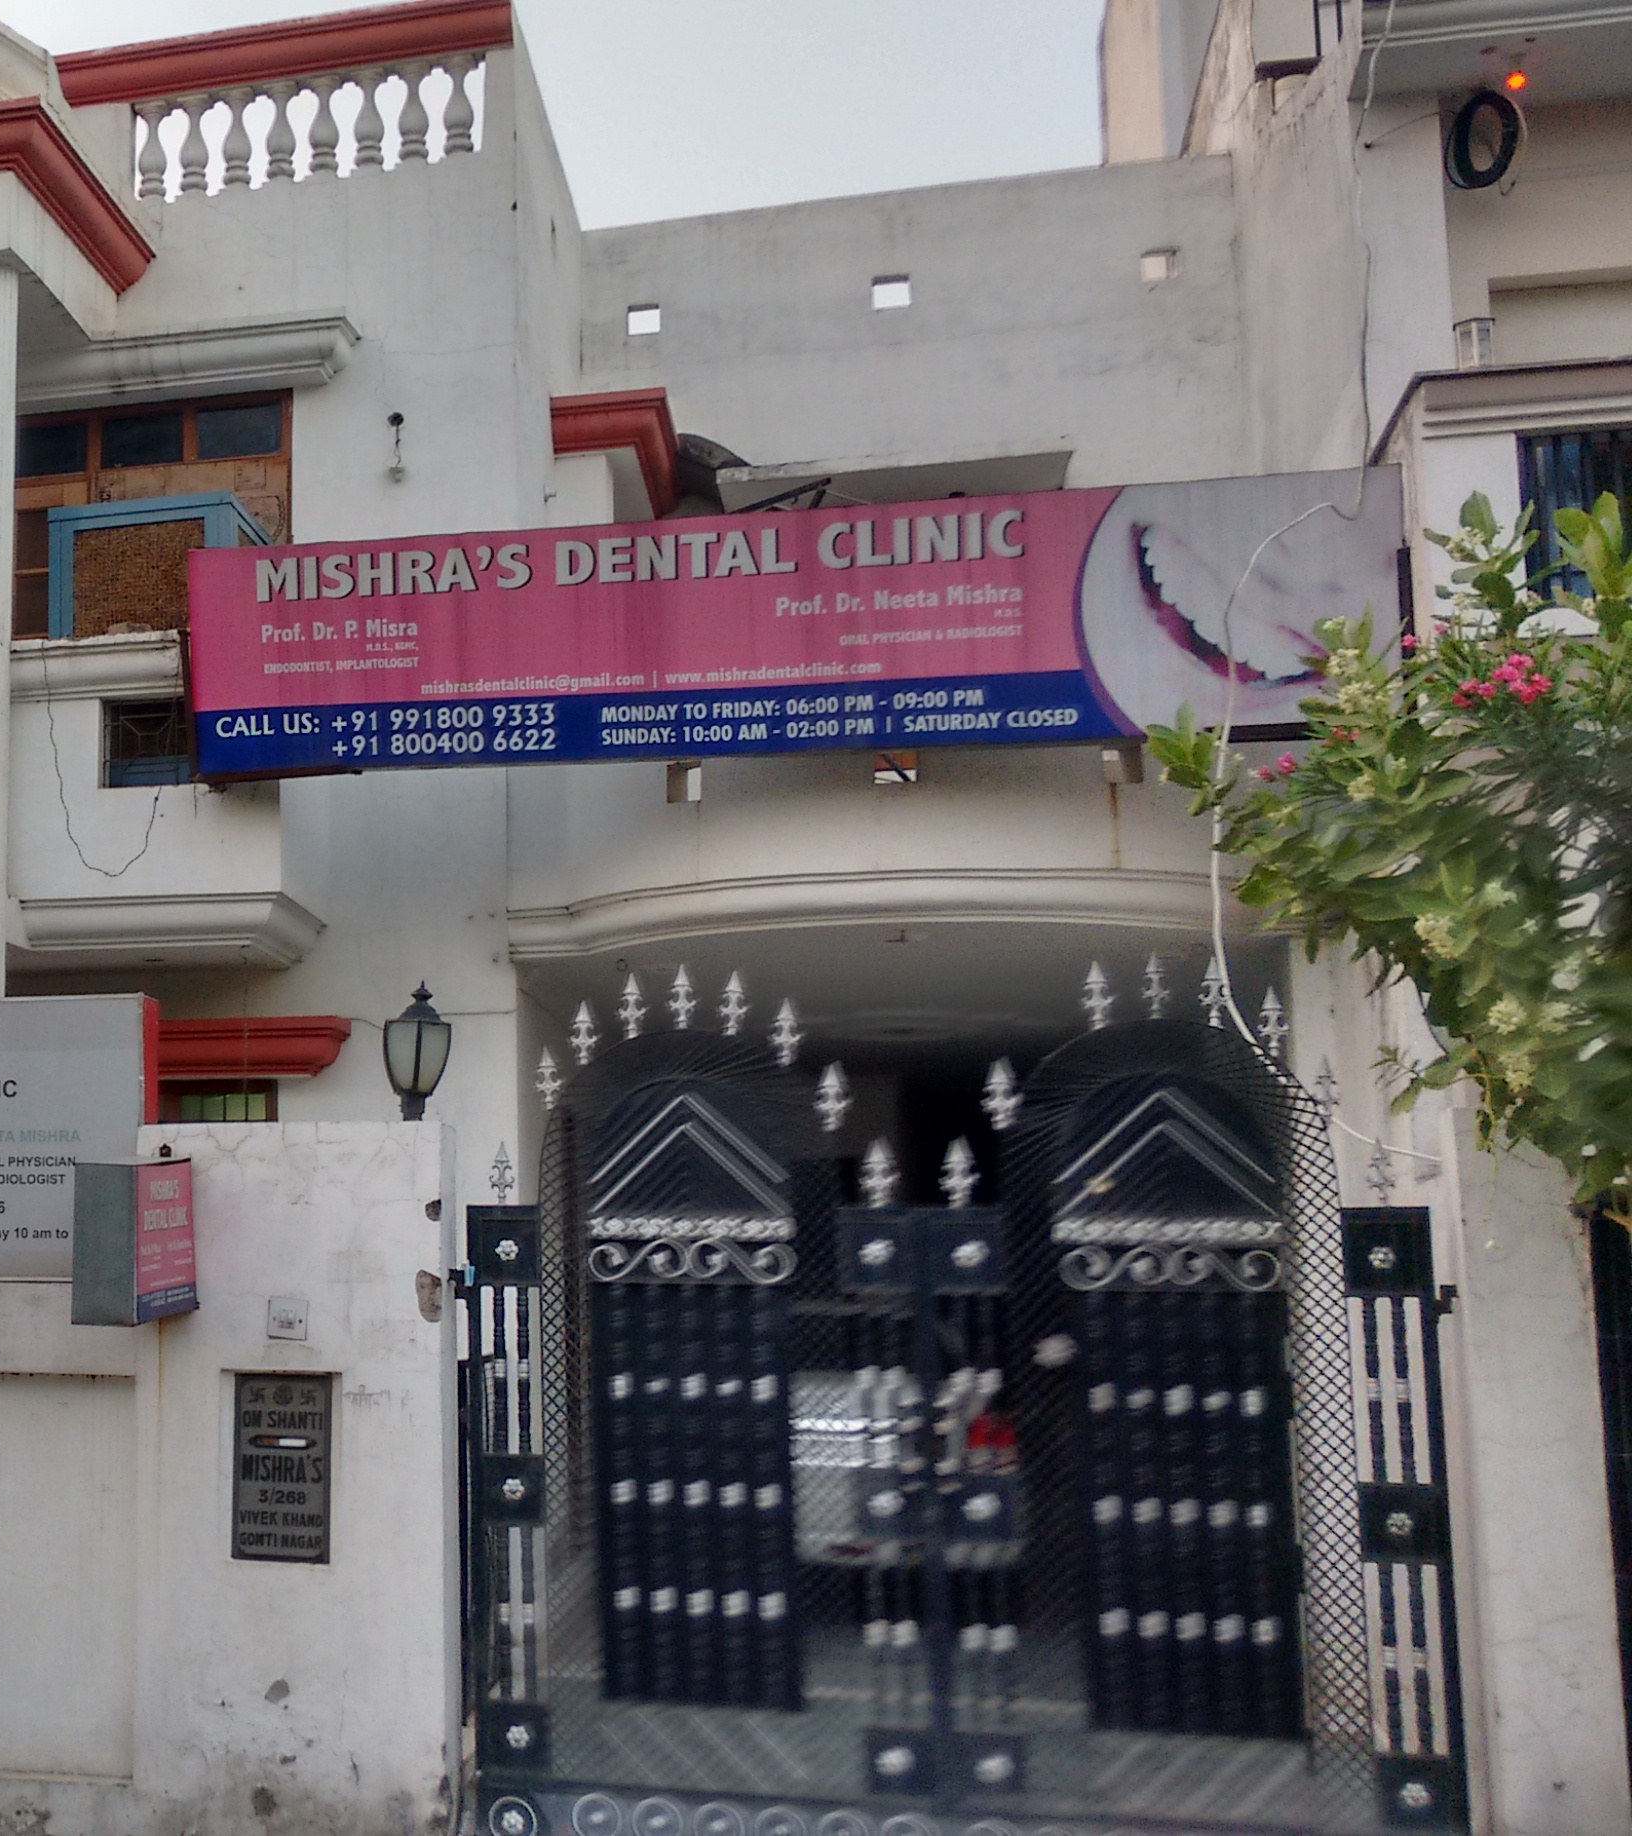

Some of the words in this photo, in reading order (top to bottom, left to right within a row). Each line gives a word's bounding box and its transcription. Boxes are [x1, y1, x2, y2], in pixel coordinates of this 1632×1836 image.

[256, 544, 532, 603] MISHRA'S
[555, 528, 798, 586] DENTAL
[818, 510, 1025, 569] CLINIC
[775, 595, 827, 616] Prof.
[836, 593, 865, 613] Dr.
[874, 588, 938, 610] Neeta
[947, 584, 1022, 606] Mishra
[261, 624, 306, 643] Prof.
[313, 622, 338, 641] Dr.
[345, 621, 359, 639] P.
[366, 619, 418, 638] Misra
[839, 634, 870, 647] ORAL
[873, 629, 931, 644] PHYSICIAN
[935, 628, 943, 641] &
[946, 625, 1022, 640] RADIOLOGIST
[264, 660, 333, 674] ENDODONTIST,
[336, 657, 419, 672] IMPLANTOLOGIST
[421, 672, 645, 695] mishrasdentalclinic@gmail.com
[665, 661, 882, 683] www.mishradentalclinic.com
[601, 703, 678, 723] MONDAY
[683, 703, 707, 720] TO
[712, 700, 780, 719] FRIDAY:
[786, 696, 839, 715] 06:00
[845, 694, 874, 712] PM
[893, 690, 948, 710] 09:00
[953, 689, 984, 707] PM
[216, 715, 274, 738] CALL
[283, 712, 320, 735] US:
[332, 710, 378, 733] +91
[389, 705, 484, 731] 991800
[492, 702, 556, 728] 9333
[601, 726, 676, 746] SUNDAY:
[683, 725, 733, 742] 10:00
[738, 723, 767, 740] AM
[786, 719, 839, 739] 02:00
[845, 718, 874, 735] PM
[904, 712, 1001, 733] SATURDAY
[1007, 708, 1079, 728] CLOSED
[332, 735, 378, 757] +91
[390, 731, 485, 755] 800400
[493, 728, 557, 751] 6622
[20, 1129, 81, 1143] MISHRA
[8, 1156, 76, 1167] PHYSICIAN
[14, 1228, 28, 1239] 10
[32, 1230, 52, 1239] am
[56, 1228, 69, 1239] to
[242, 1411, 261, 1428] OM
[268, 1411, 322, 1431] SHANTI
[241, 1454, 323, 1483] MISHRA'S
[258, 1488, 306, 1505] 3/268
[239, 1511, 278, 1526] VIVEK
[282, 1511, 323, 1528] KHAND
[239, 1532, 277, 1547] GOMTI
[280, 1533, 322, 1549] NAGAR
